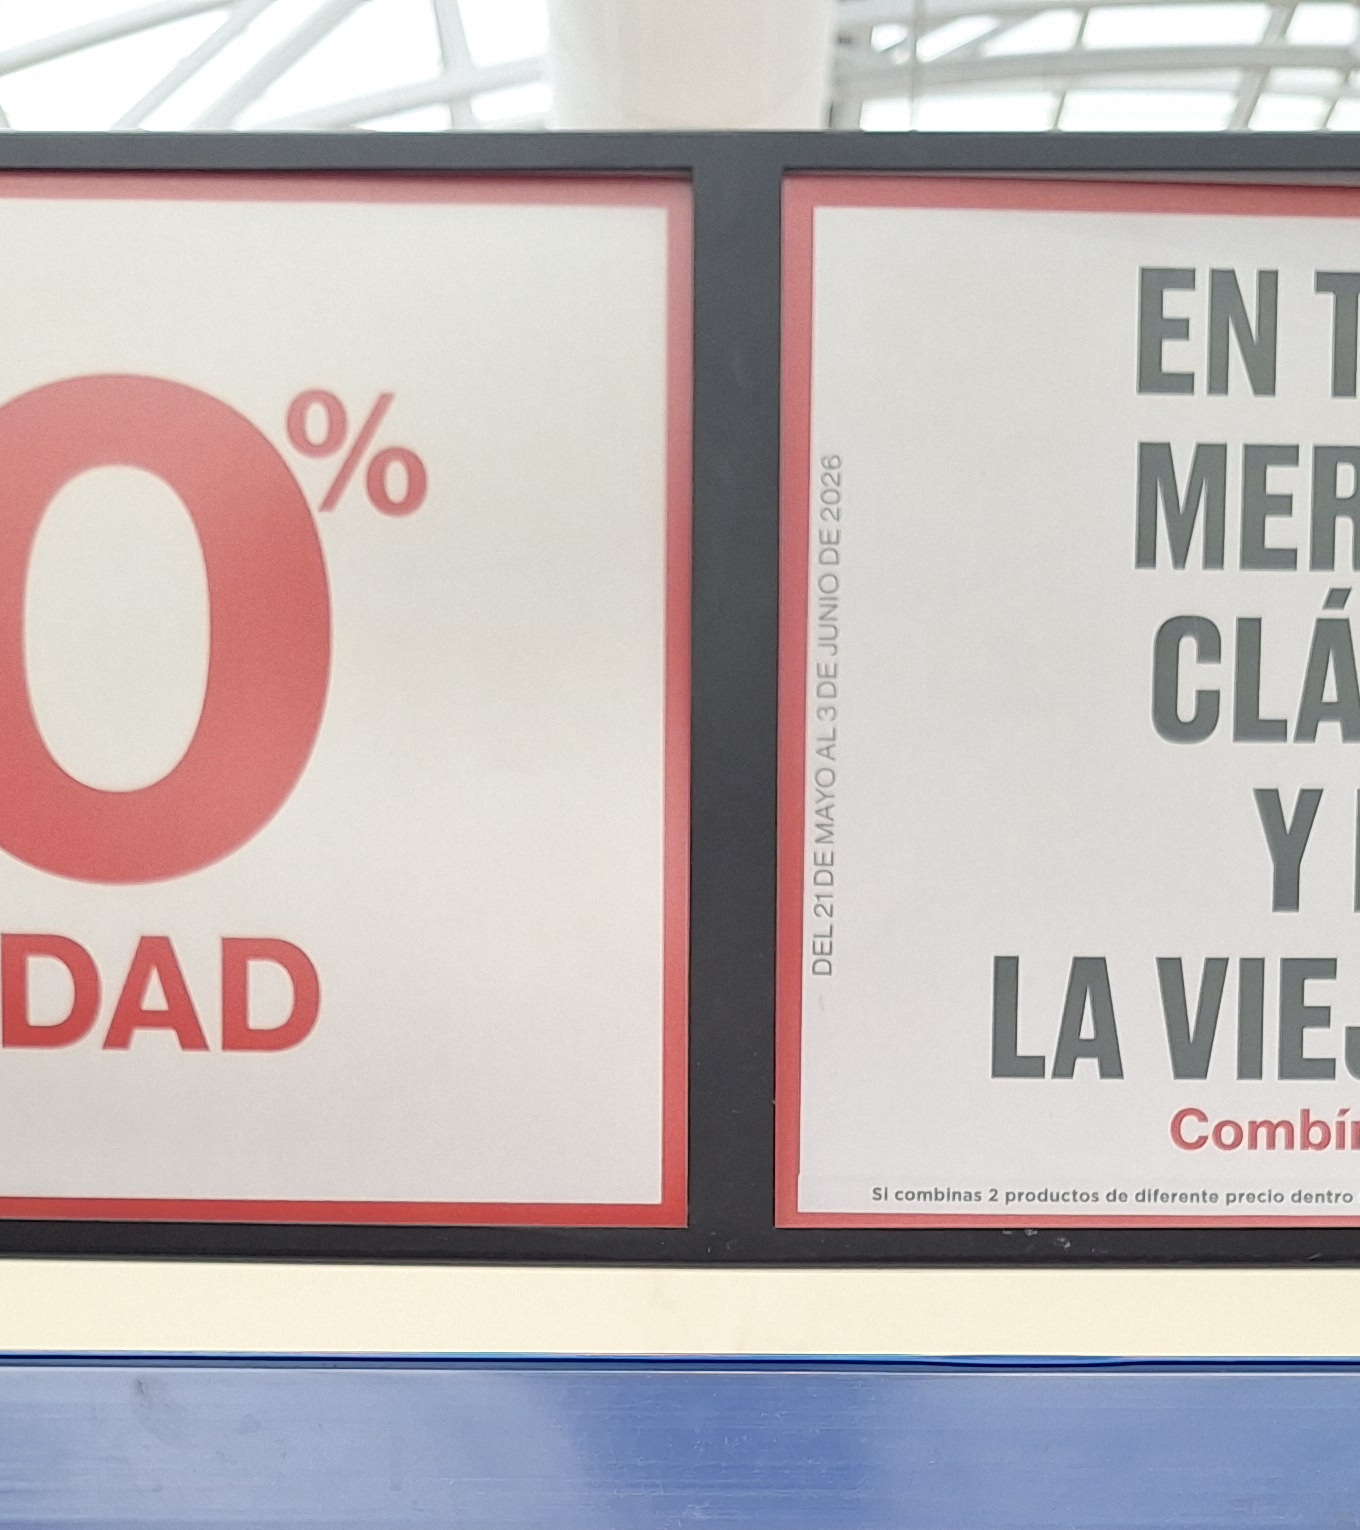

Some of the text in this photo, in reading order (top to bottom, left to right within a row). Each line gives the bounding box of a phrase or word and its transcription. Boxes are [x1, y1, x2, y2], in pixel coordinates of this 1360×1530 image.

[1137, 267, 1278, 396] EN
[812, 455, 841, 975] DEL 21 DE MAYO AL 3 DE JUNIO DE 2026
[1253, 788, 1323, 912] Y
[991, 956, 1124, 1079] LA
[895, 1188, 981, 1201] combinas
[989, 1189, 998, 1202] 2
[1006, 1188, 1099, 1205] productos
[1106, 1189, 1127, 1202] de
[1135, 1189, 1218, 1203] diferente
[1226, 1189, 1284, 1206] precio
[1291, 1190, 1353, 1203] dentro
